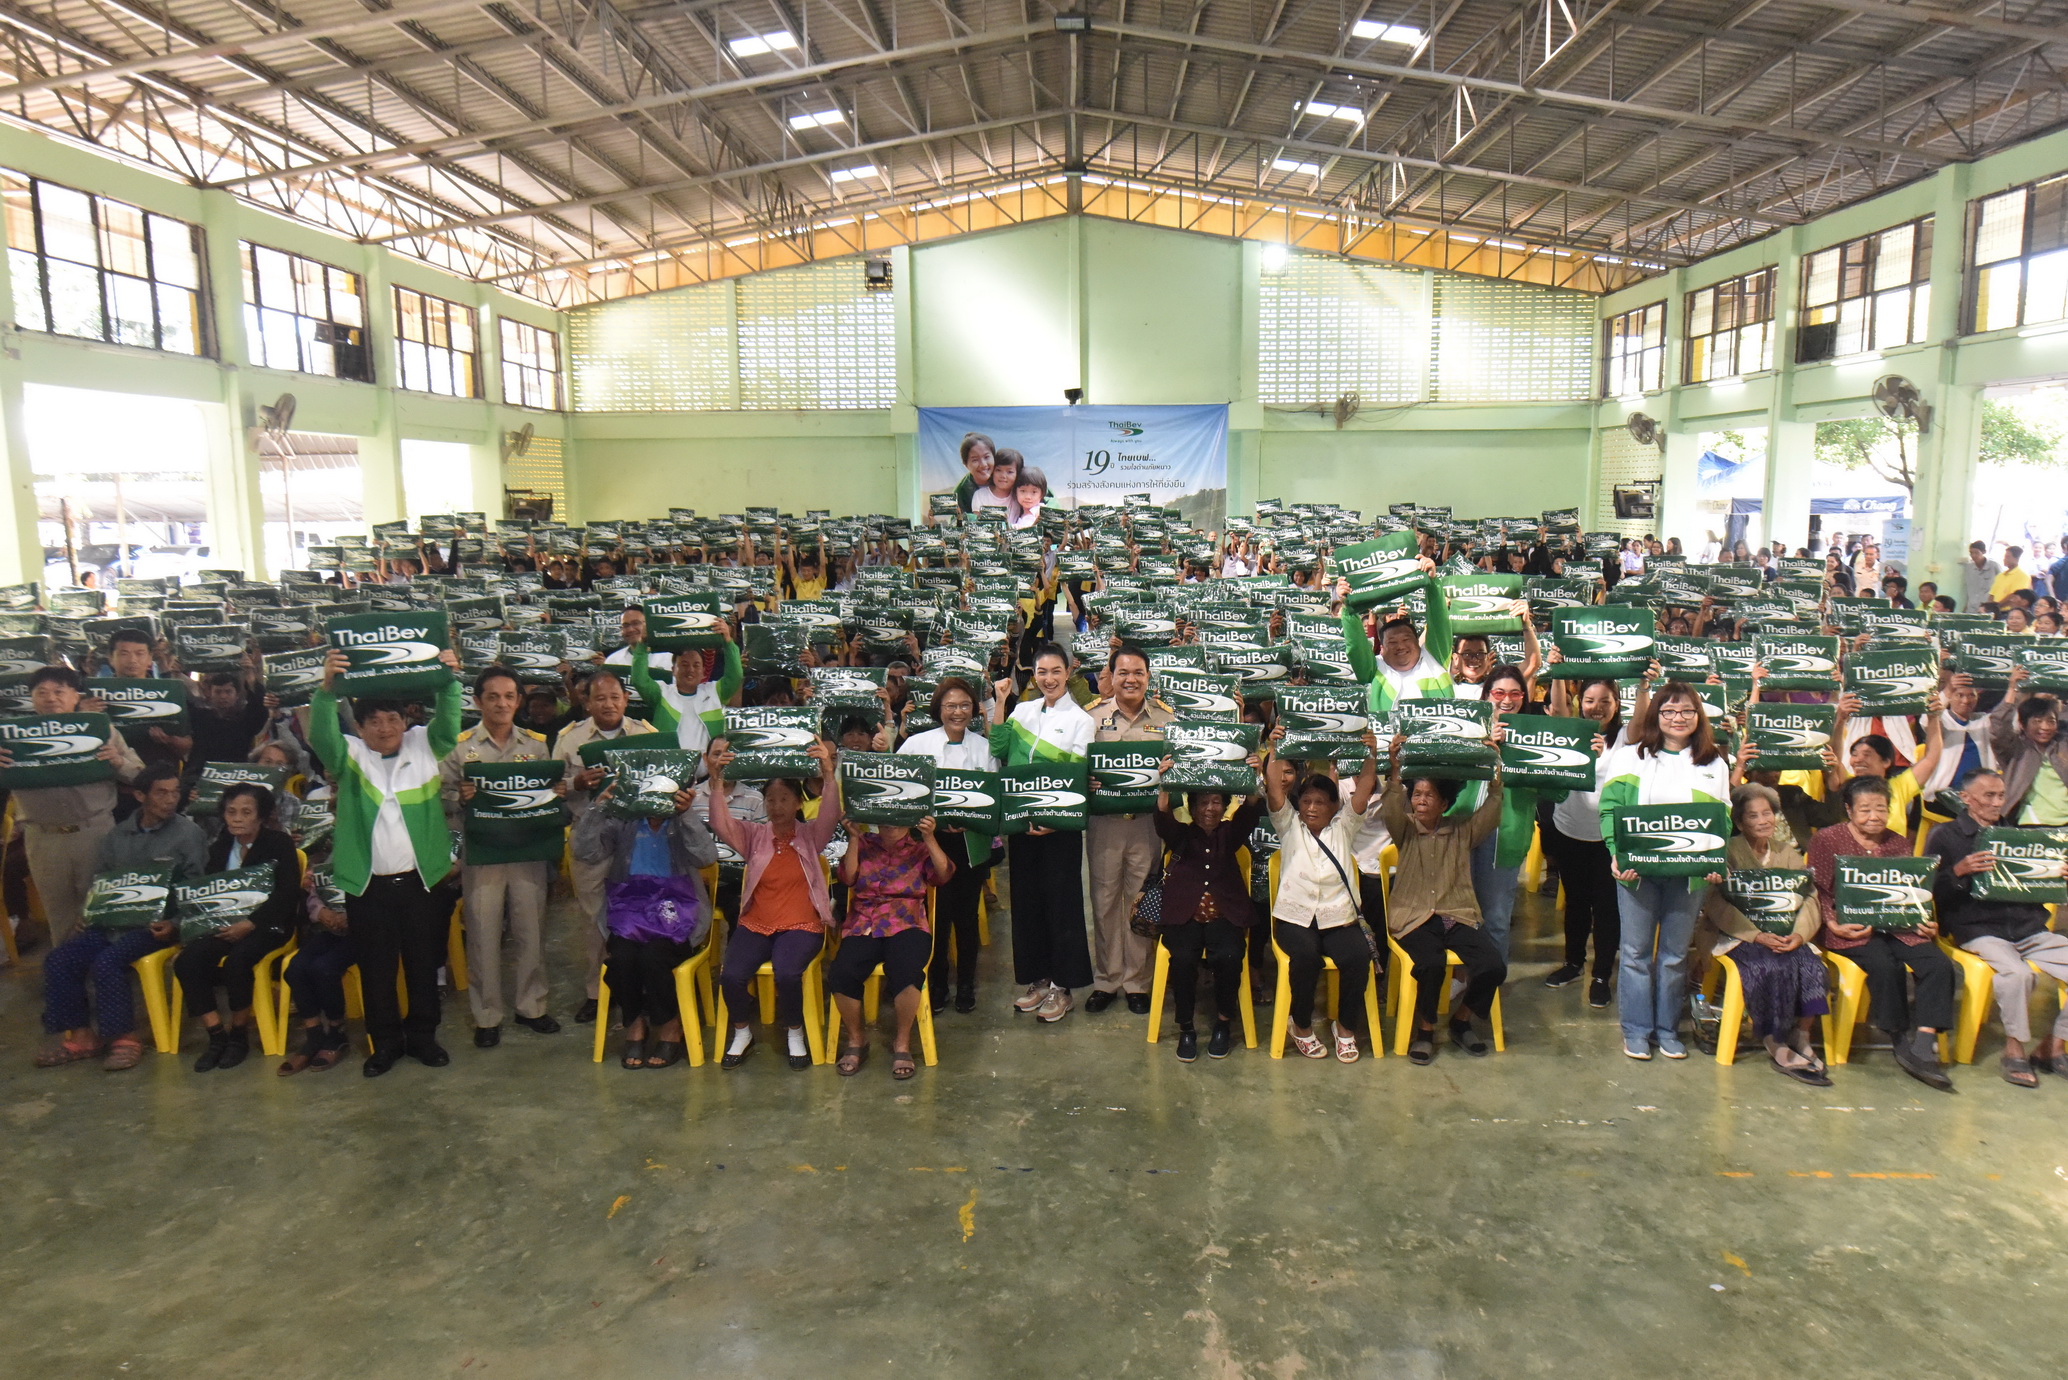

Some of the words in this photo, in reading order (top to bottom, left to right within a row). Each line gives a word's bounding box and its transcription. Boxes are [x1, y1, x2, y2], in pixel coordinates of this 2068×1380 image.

[1082, 450, 1110, 475] 19
[1118, 453, 1156, 461] ไทยเบฟ...
[1862, 499, 1897, 512] Chang
[1339, 547, 1408, 572] ThaiBev
[712, 569, 746, 578] ThaiBev
[1565, 565, 1597, 573] ThaiBev
[595, 582, 634, 590] ThaiBev
[1105, 579, 1142, 587] ThaiBev
[1244, 580, 1282, 588] ThaiBev
[1712, 575, 1753, 585] ThaiBev
[1443, 584, 1509, 596] ThaiBev
[1661, 581, 1701, 592] ThaiBev
[1277, 594, 1322, 603] ThaiBev
[1533, 588, 1578, 598] ThaiBev
[1777, 588, 1815, 598] ThaiBev
[648, 602, 710, 614] ThaiBev
[892, 598, 936, 607] ThaiBev
[1744, 604, 1789, 612] ThaiBev
[450, 608, 493, 622] ThaiBev
[783, 604, 833, 614] ThaiBev
[1119, 610, 1168, 619] ThaiBev
[595, 615, 622, 625] Thai
[1200, 610, 1246, 621] ThaiBev
[1866, 614, 1919, 624] ThaiBev
[855, 617, 900, 627] ThaiBev
[954, 618, 999, 630] ThaiBev
[1562, 619, 1640, 635] ThaiBev
[334, 626, 428, 645] ThaiBev
[1764, 625, 1812, 635] ThaiBev
[462, 638, 496, 648] ThaiB
[1201, 633, 1255, 642] ThaiBev
[499, 642, 550, 653] ThaiBev
[1073, 640, 1109, 650] ThaiBe
[1494, 642, 1525, 652] Thai
[1656, 642, 1707, 653] ThaiBev
[1762, 643, 1825, 655] ThaiBev
[1964, 644, 2013, 658] ThaiBe
[923, 648, 975, 662] ThaiBev
[1218, 652, 1278, 664] ThaiBev
[1307, 649, 1348, 661] ThaiB
[1714, 647, 1753, 657] ThaiB
[2023, 651, 2068, 661] ThaiB
[813, 670, 871, 679] ThaiBev
[1852, 663, 1926, 680] ThaiBev
[1161, 676, 1228, 693] ThaiBev
[91, 688, 169, 701] ThaiBev
[1282, 695, 1359, 712] ThaiBev
[1401, 704, 1477, 719] ThaiBev
[1752, 714, 1823, 729] ThaiBev
[0, 721, 90, 739] ThaiBev
[1165, 726, 1240, 740] ThaiBev
[1503, 728, 1579, 746] ThaiBev
[202, 767, 269, 781] ThaiBev
[842, 762, 918, 779] ThaiBev
[469, 776, 551, 790] ThaiBev
[936, 777, 985, 790] aiBev
[1001, 777, 1074, 793] ThaiBev
[301, 801, 328, 814] Thai
[1623, 815, 1712, 832] ThaiBev
[1989, 840, 2067, 857] ThaiBev
[1628, 853, 1724, 863] ไทยเบฟ...รวมใจต้านภัยหนาว
[1841, 867, 1926, 884] ThaiBev
[93, 873, 162, 891] ThaiBev
[1728, 875, 1803, 891] ThaiBev
[176, 877, 253, 901] ThaiBev
